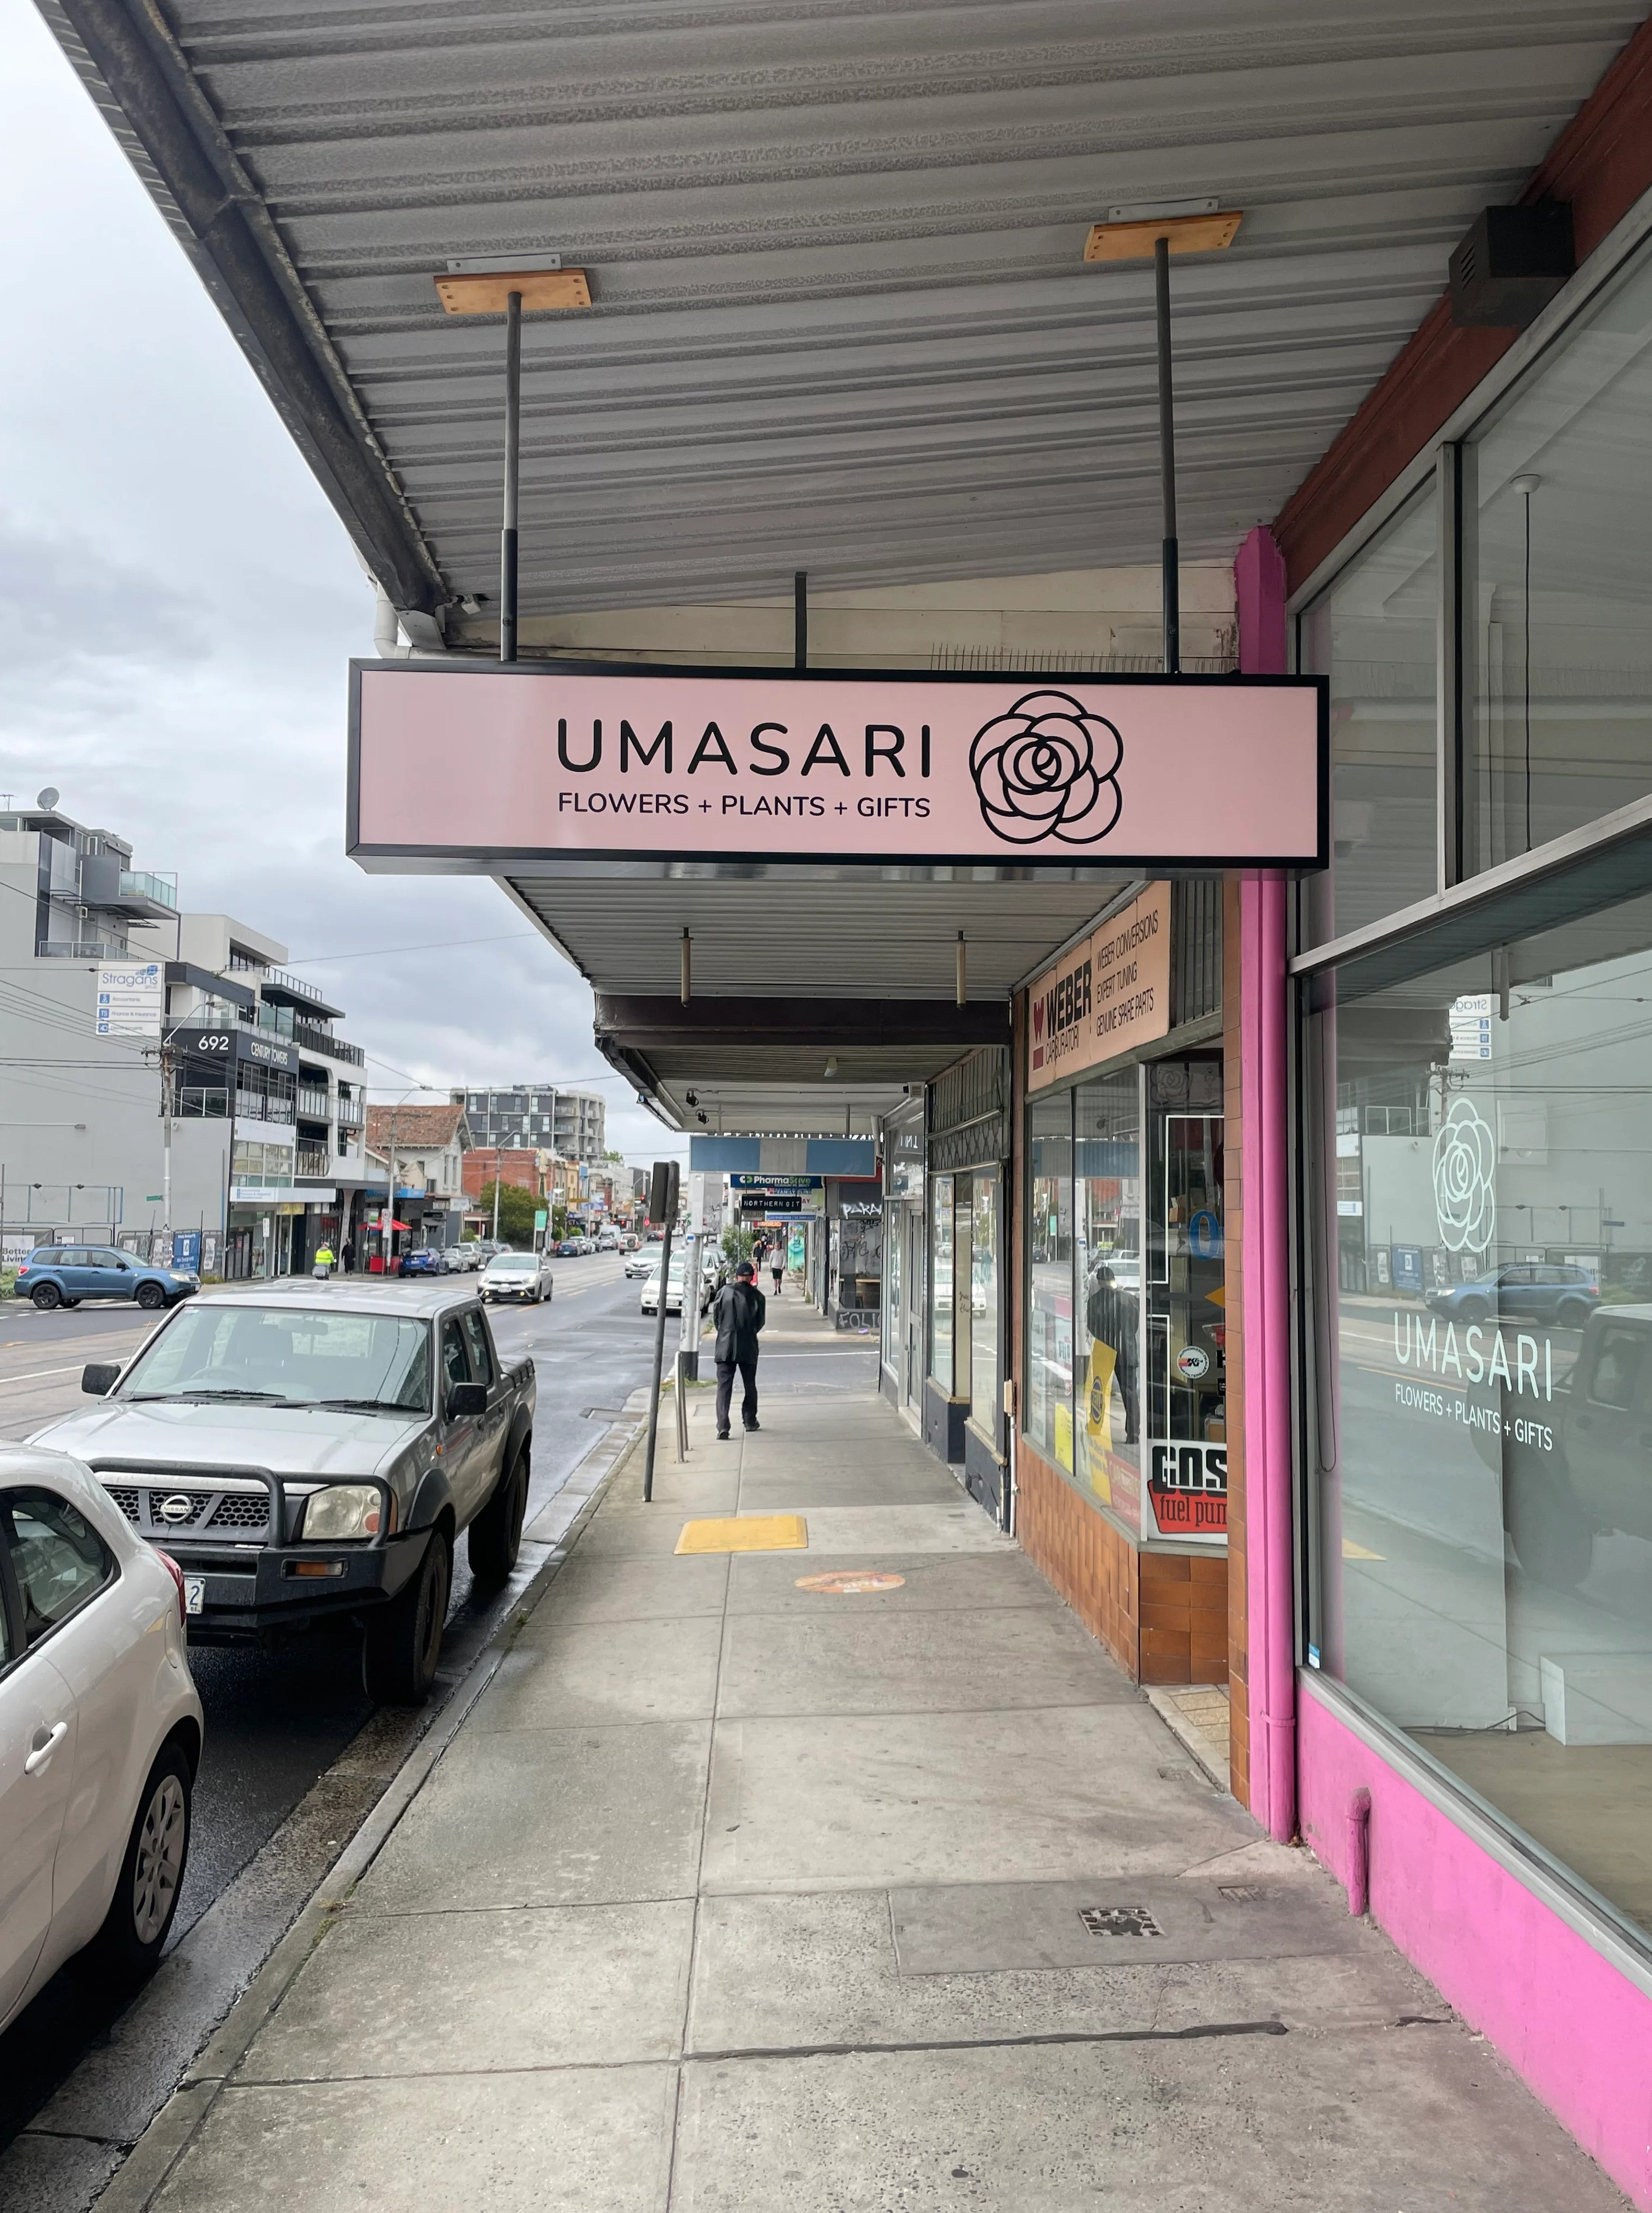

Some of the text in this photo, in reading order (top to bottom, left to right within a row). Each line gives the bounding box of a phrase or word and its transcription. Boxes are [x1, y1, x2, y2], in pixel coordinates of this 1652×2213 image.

[558, 719, 930, 778] UMASARI
[559, 793, 930, 817] FLOWERS + PLANTS + GIFTS
[1098, 909, 1158, 972] WEBER CONVERSIONS
[102, 972, 158, 987] Stragans
[1047, 960, 1092, 1039] WEBER
[1097, 961, 1137, 1004] EXPERT TUNING
[1097, 987, 1154, 1037] GENUINE SPARE PARTS
[198, 1036, 229, 1050] 692
[251, 1042, 288, 1066] CENTURY TOWERS
[1046, 1024, 1080, 1065] CARBURATORI
[754, 1176, 811, 1185] PharmaSave
[1394, 1312, 1552, 1402] UMASARI
[1395, 1383, 1553, 1451] FLOWERS + PLANTS + GIFTS
[1160, 1495, 1191, 1522] fuel
